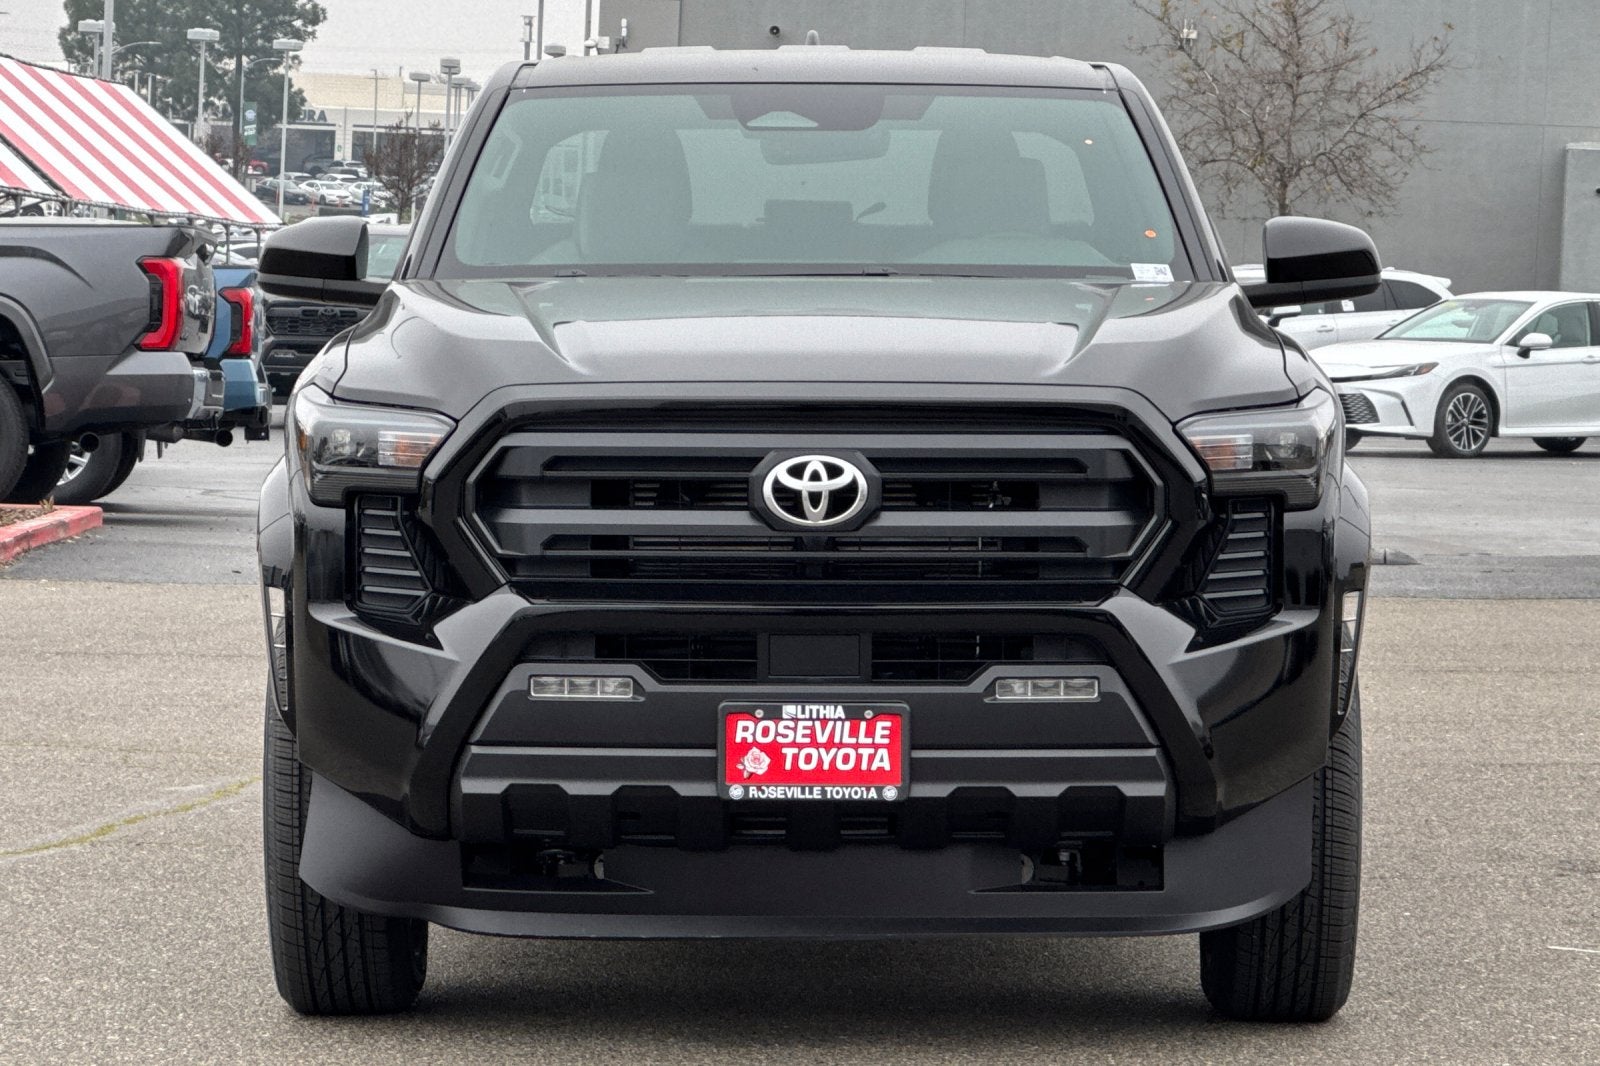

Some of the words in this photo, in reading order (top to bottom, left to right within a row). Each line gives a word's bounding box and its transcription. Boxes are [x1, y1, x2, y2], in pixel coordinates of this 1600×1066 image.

[796, 705, 845, 719] LITHIA
[735, 720, 892, 744] ROSEVILLE
[782, 747, 891, 771] TOYOTA
[749, 786, 822, 799] ROSEVILLE
